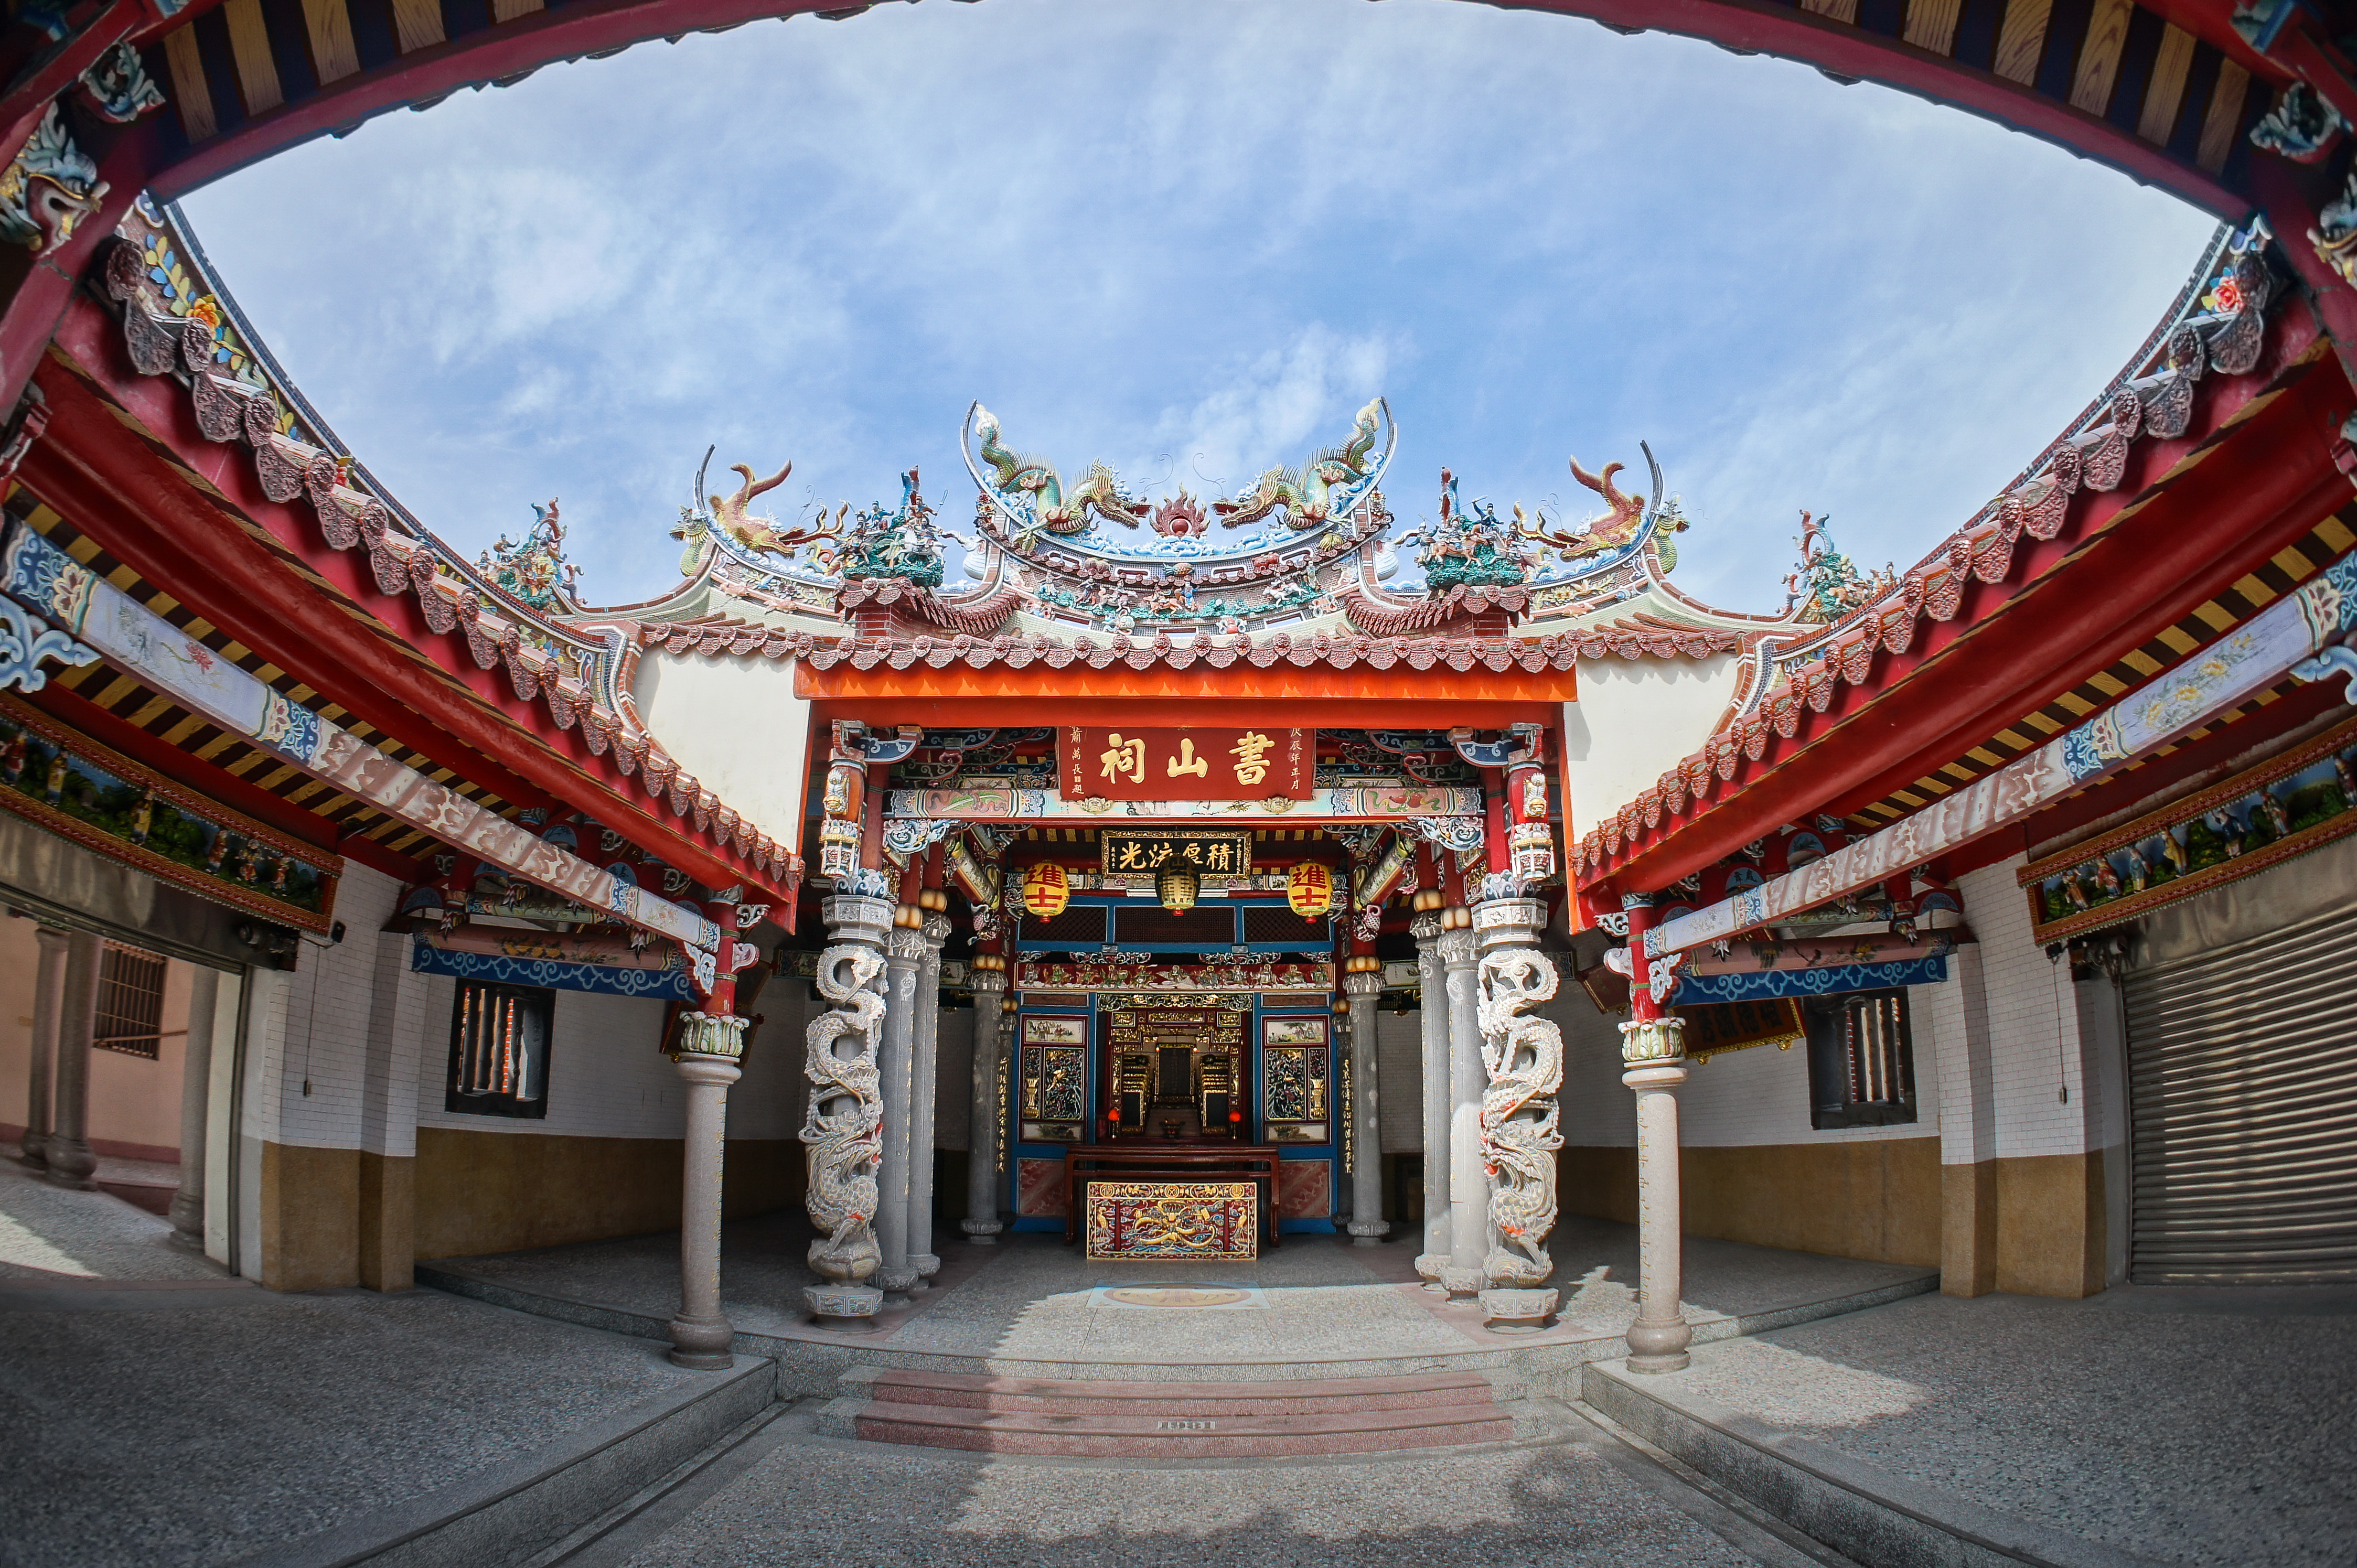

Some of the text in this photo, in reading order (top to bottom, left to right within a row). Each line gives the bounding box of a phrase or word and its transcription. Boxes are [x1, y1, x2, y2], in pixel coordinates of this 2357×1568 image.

[1100, 731, 1275, 785] 書山祠
[1025, 864, 1064, 908] 進士
[1292, 865, 1327, 907] 進士
